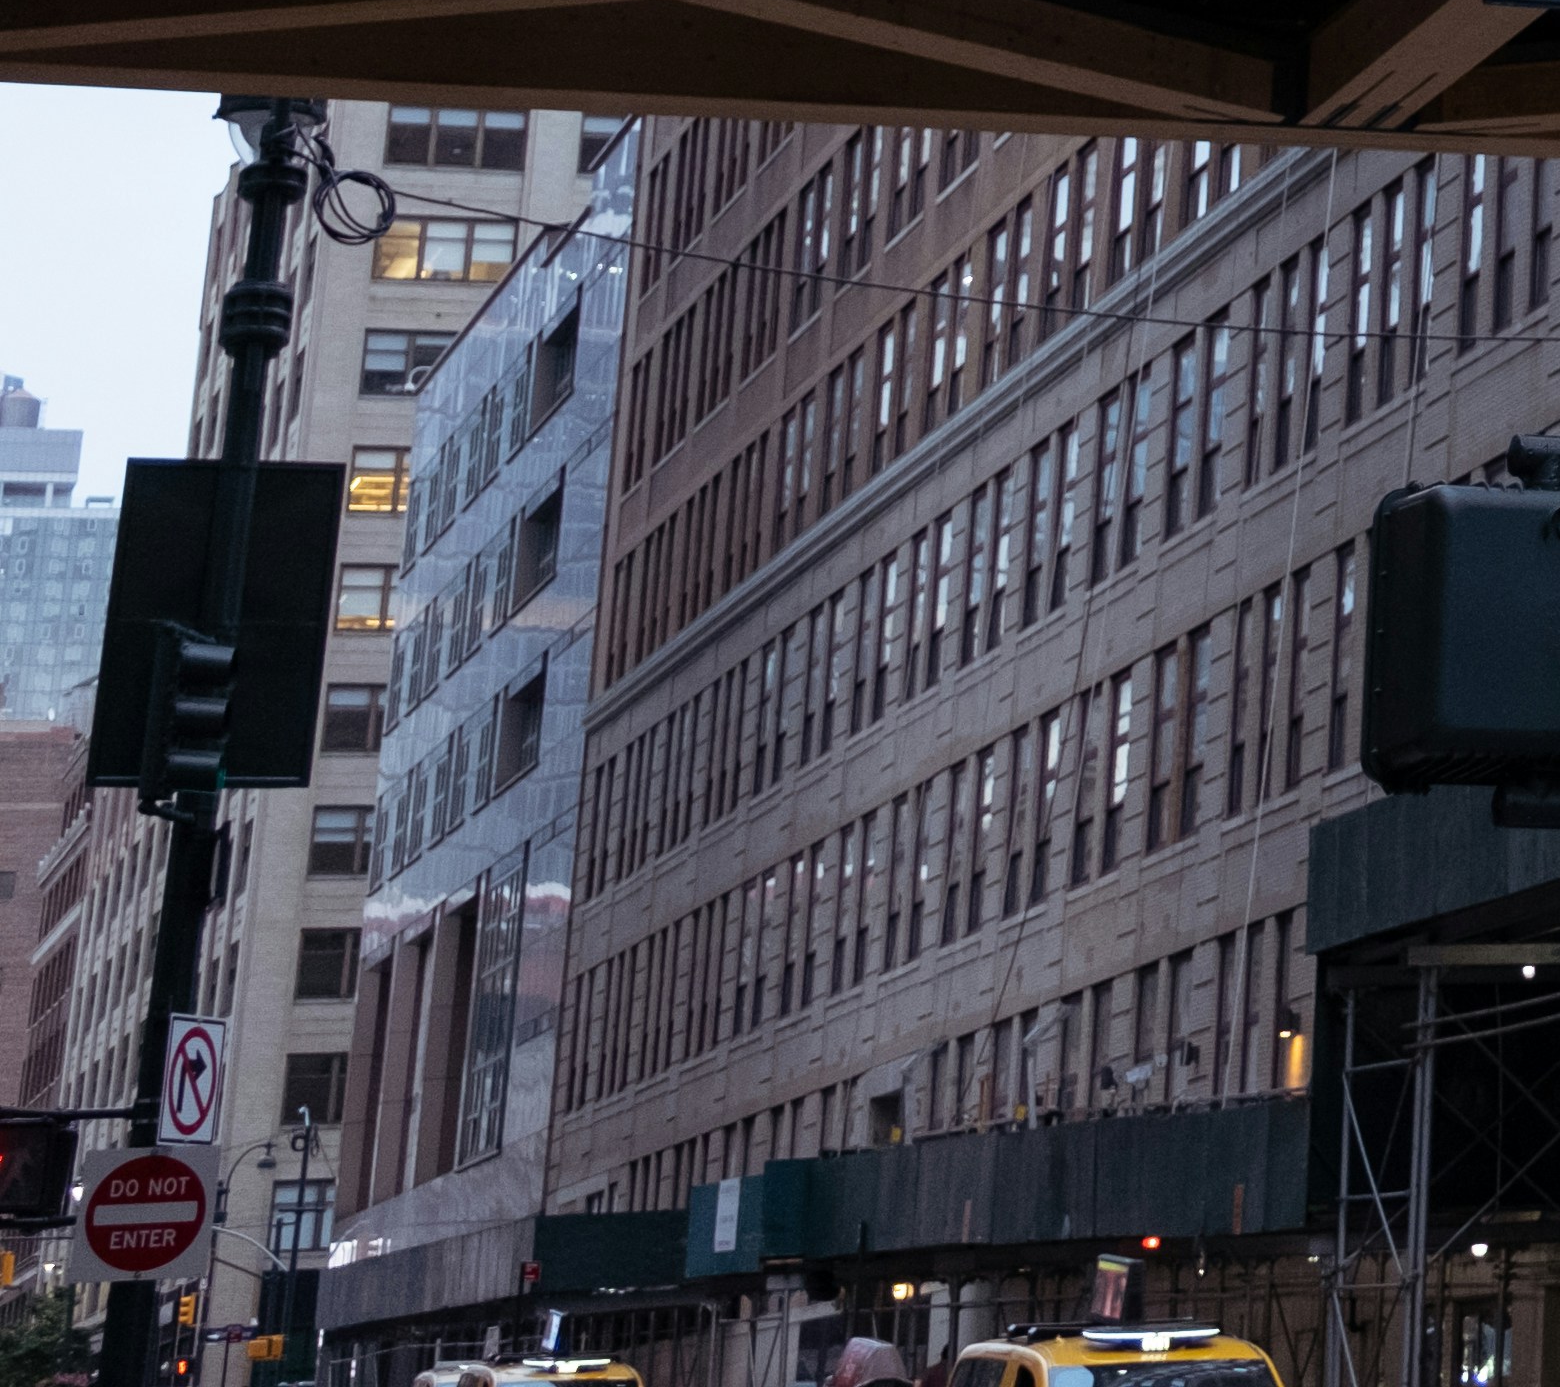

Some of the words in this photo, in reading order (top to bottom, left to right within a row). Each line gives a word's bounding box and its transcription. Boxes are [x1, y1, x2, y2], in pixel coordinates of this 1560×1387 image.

[110, 1179, 139, 1197] DO
[148, 1177, 190, 1195] NOT
[110, 1229, 177, 1249] ENTER
